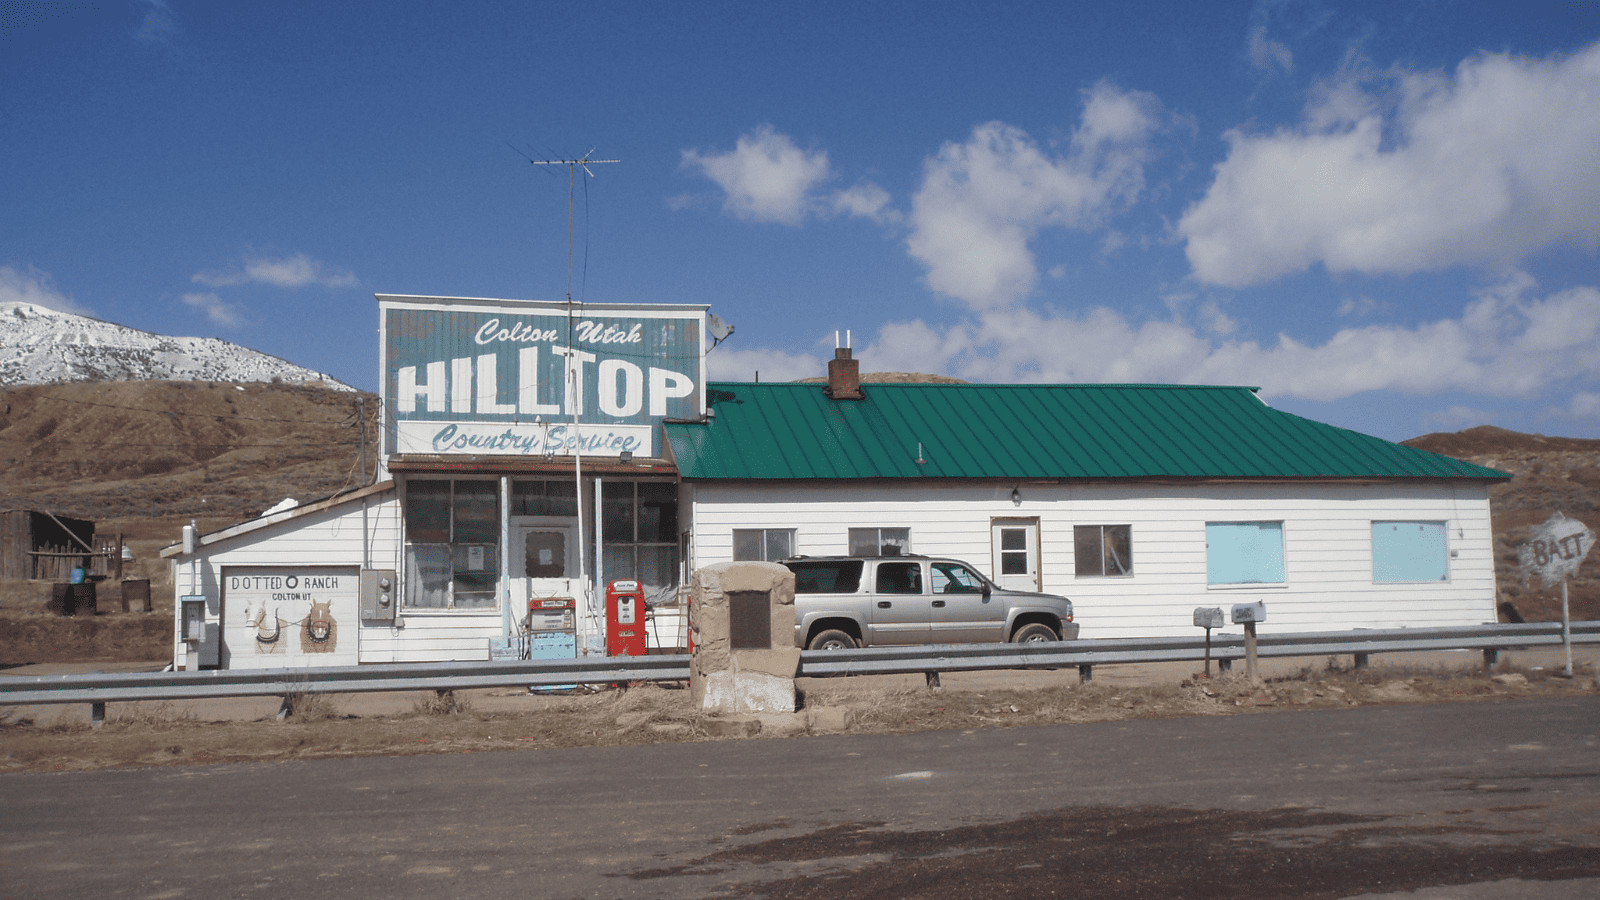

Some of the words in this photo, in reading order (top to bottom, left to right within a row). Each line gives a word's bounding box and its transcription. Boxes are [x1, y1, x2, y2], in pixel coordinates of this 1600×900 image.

[475, 318, 558, 345] Colton
[575, 320, 642, 344] Utah
[397, 346, 695, 417] HILLTOP
[432, 423, 539, 452] Country
[545, 425, 642, 452] Service
[1533, 532, 1585, 566] BAIT
[232, 577, 282, 590] DOTTED
[304, 577, 338, 589] RANCH
[272, 592, 301, 601] COLTON
[302, 593, 311, 601] UT
